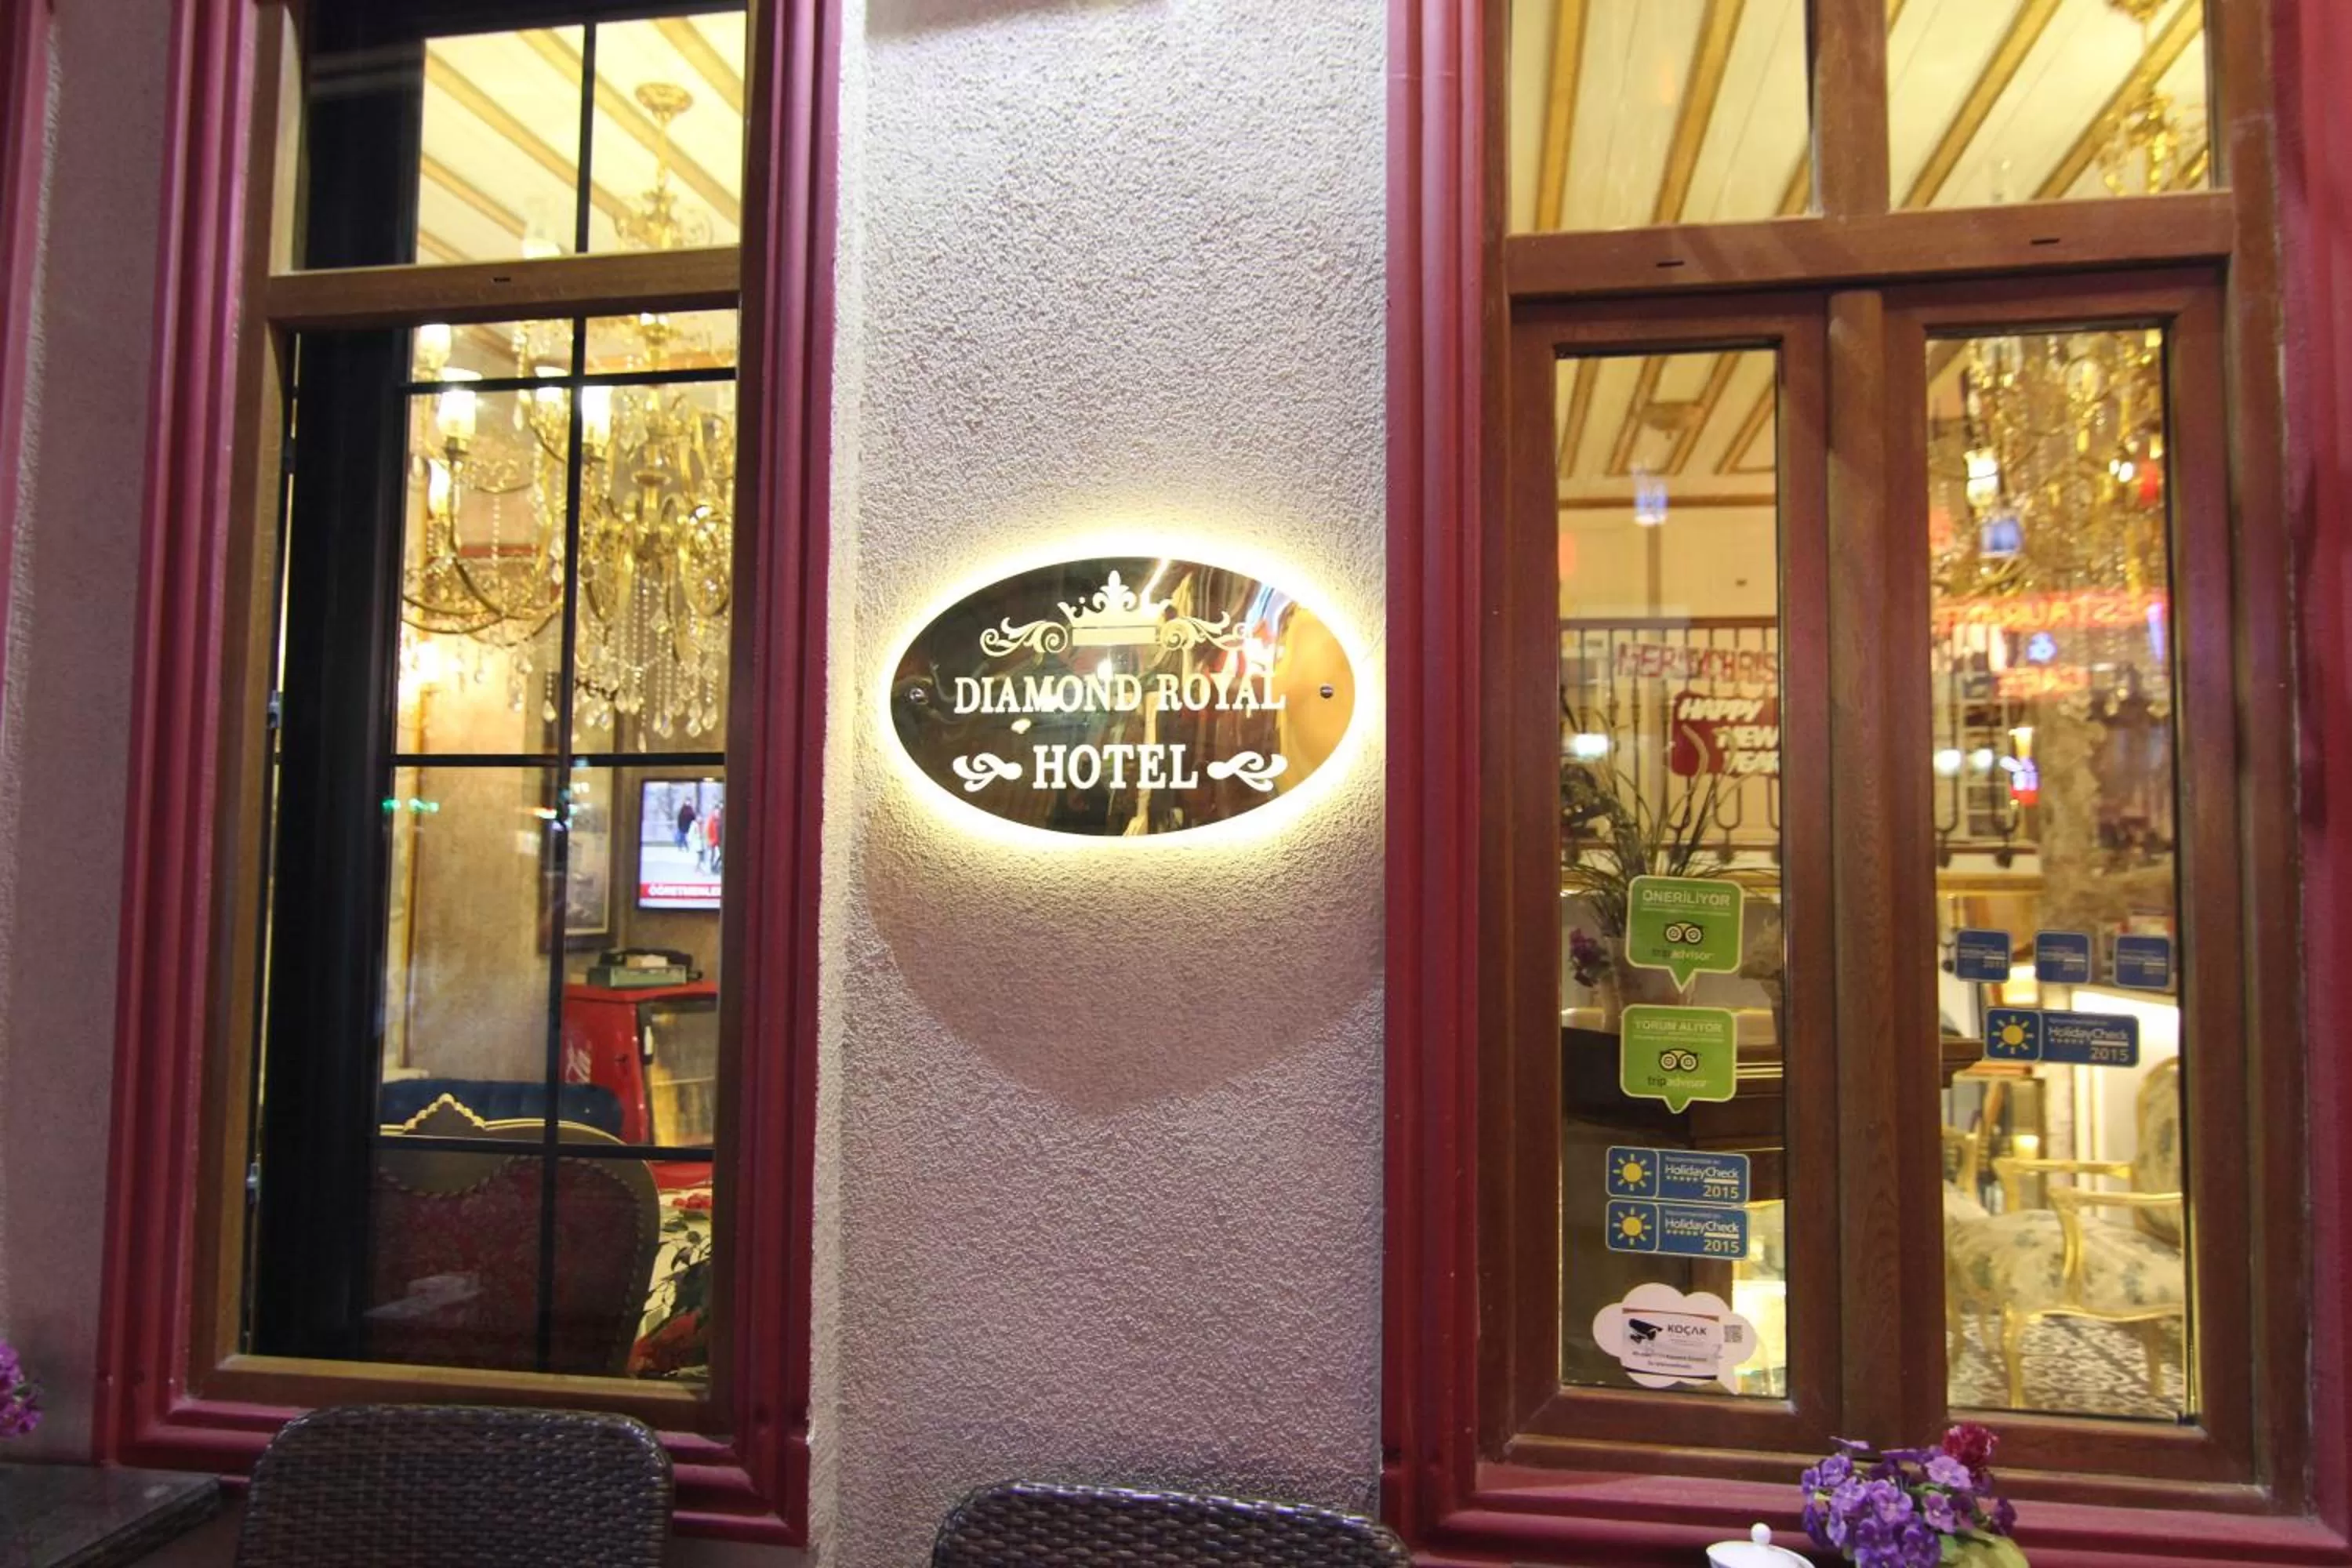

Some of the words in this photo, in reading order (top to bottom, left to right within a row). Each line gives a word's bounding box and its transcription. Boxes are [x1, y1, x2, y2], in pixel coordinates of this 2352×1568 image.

[954, 674, 1142, 715] DIAMOND
[1156, 673, 1287, 711] ROYAL
[1678, 697, 1763, 722] HAPPY
[1033, 744, 1200, 790] HOTEL
[2089, 1047, 2129, 1062] 2015
[1664, 1163, 1739, 1180] HolidayCheck
[1702, 1185, 1740, 1199] 2015
[1664, 1218, 1740, 1234] HolidayCheck
[1703, 1239, 1740, 1254] 2015
